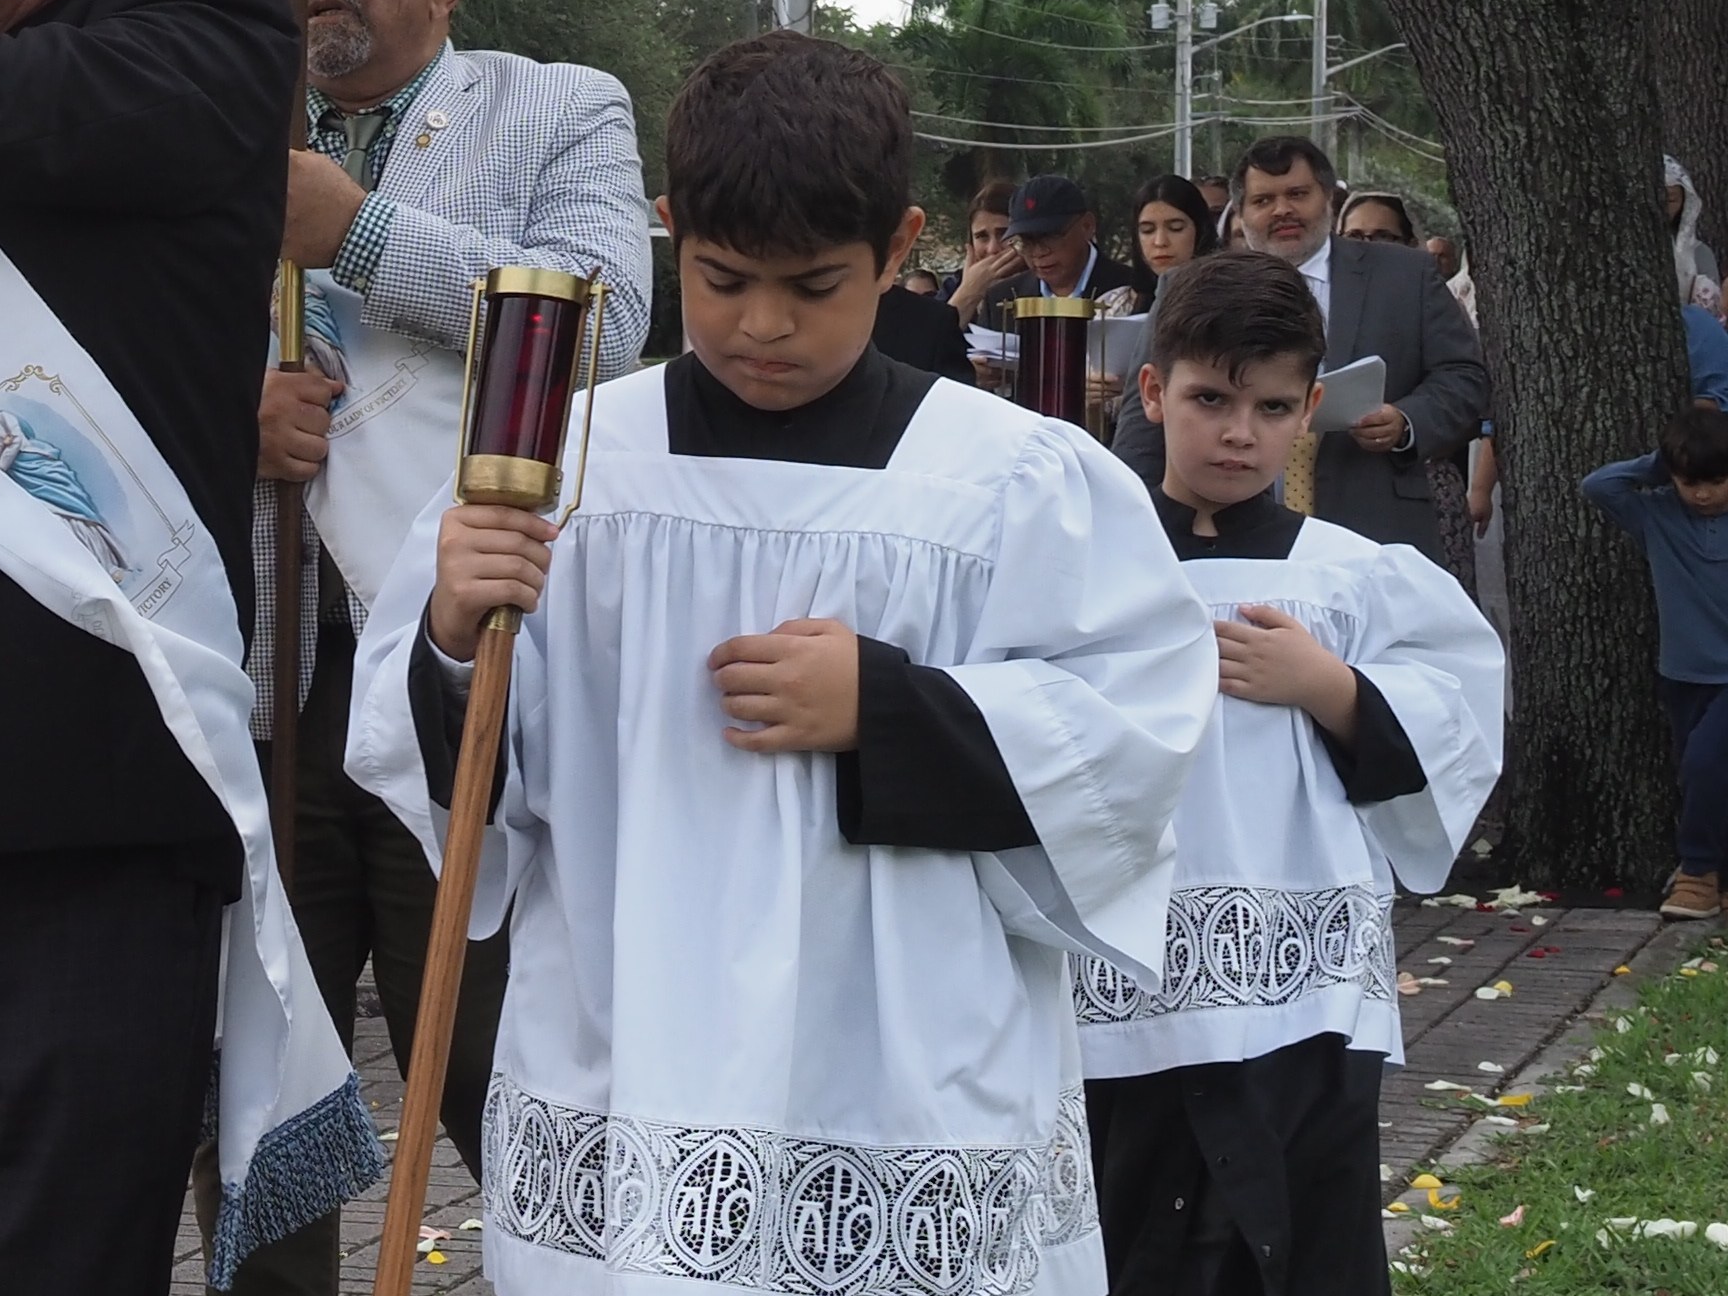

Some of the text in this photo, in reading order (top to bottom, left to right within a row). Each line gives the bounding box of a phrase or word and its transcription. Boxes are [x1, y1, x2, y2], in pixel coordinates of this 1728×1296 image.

[327, 379, 407, 435] OUR LADY OF VICTORY
